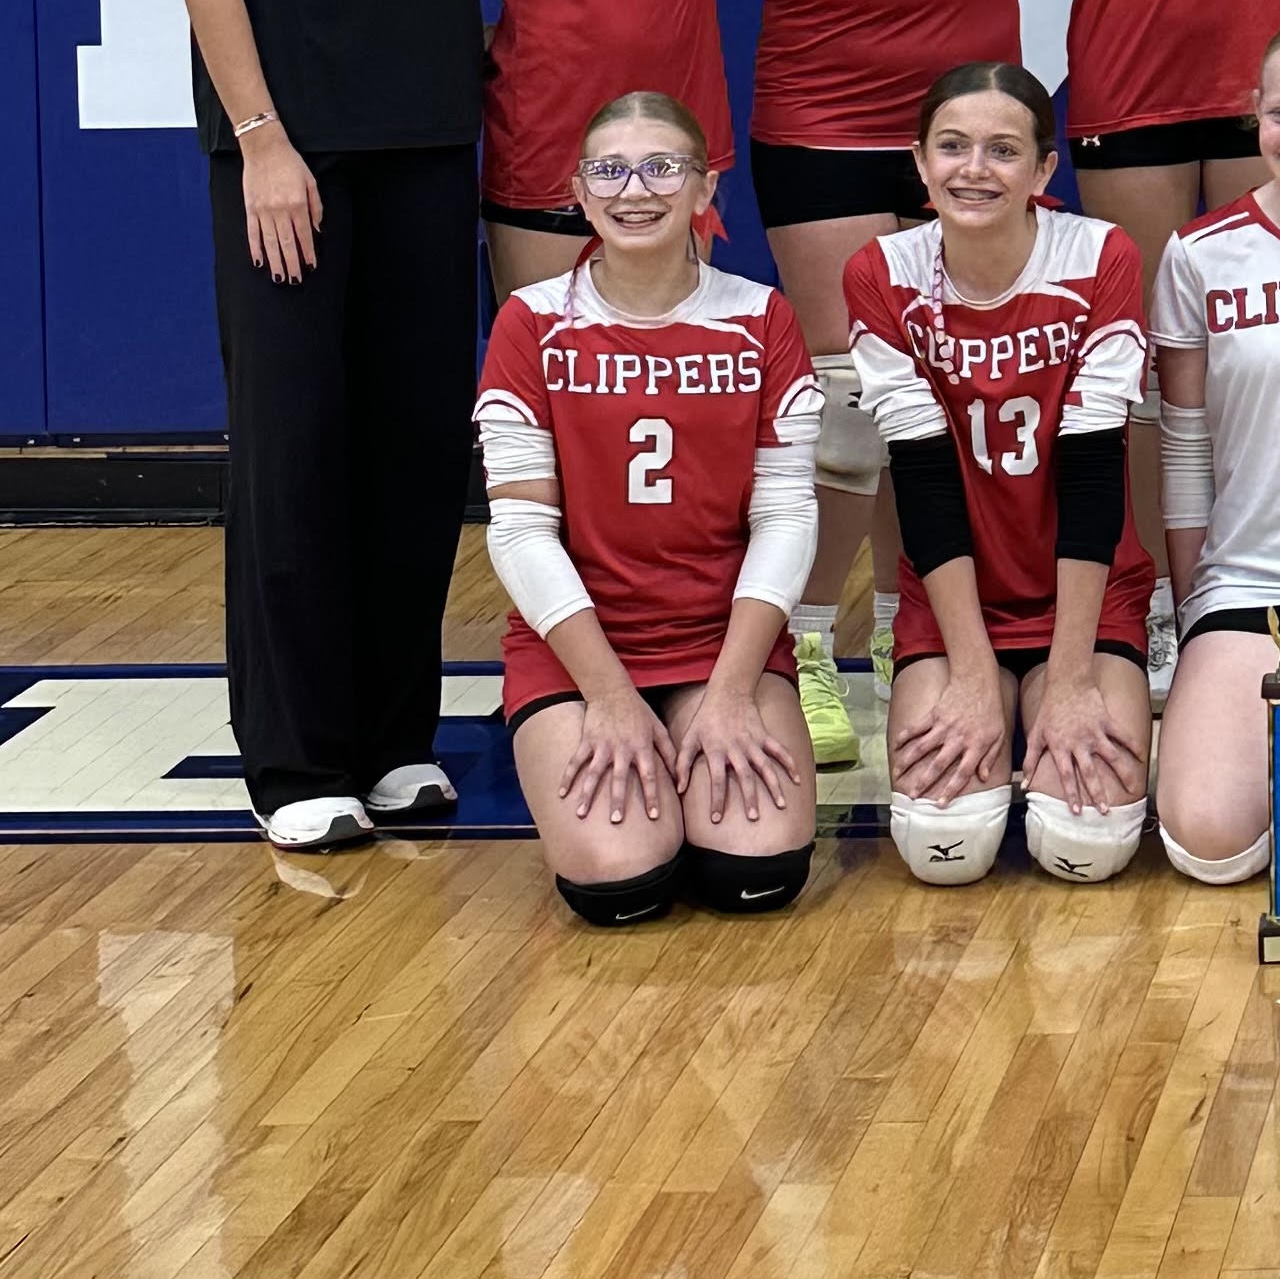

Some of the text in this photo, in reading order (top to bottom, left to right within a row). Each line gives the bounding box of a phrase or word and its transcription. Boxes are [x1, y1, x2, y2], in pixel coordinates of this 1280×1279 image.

[542, 348, 762, 395] CLIPPERS
[628, 418, 673, 504] 2
[967, 396, 1041, 476] 13
